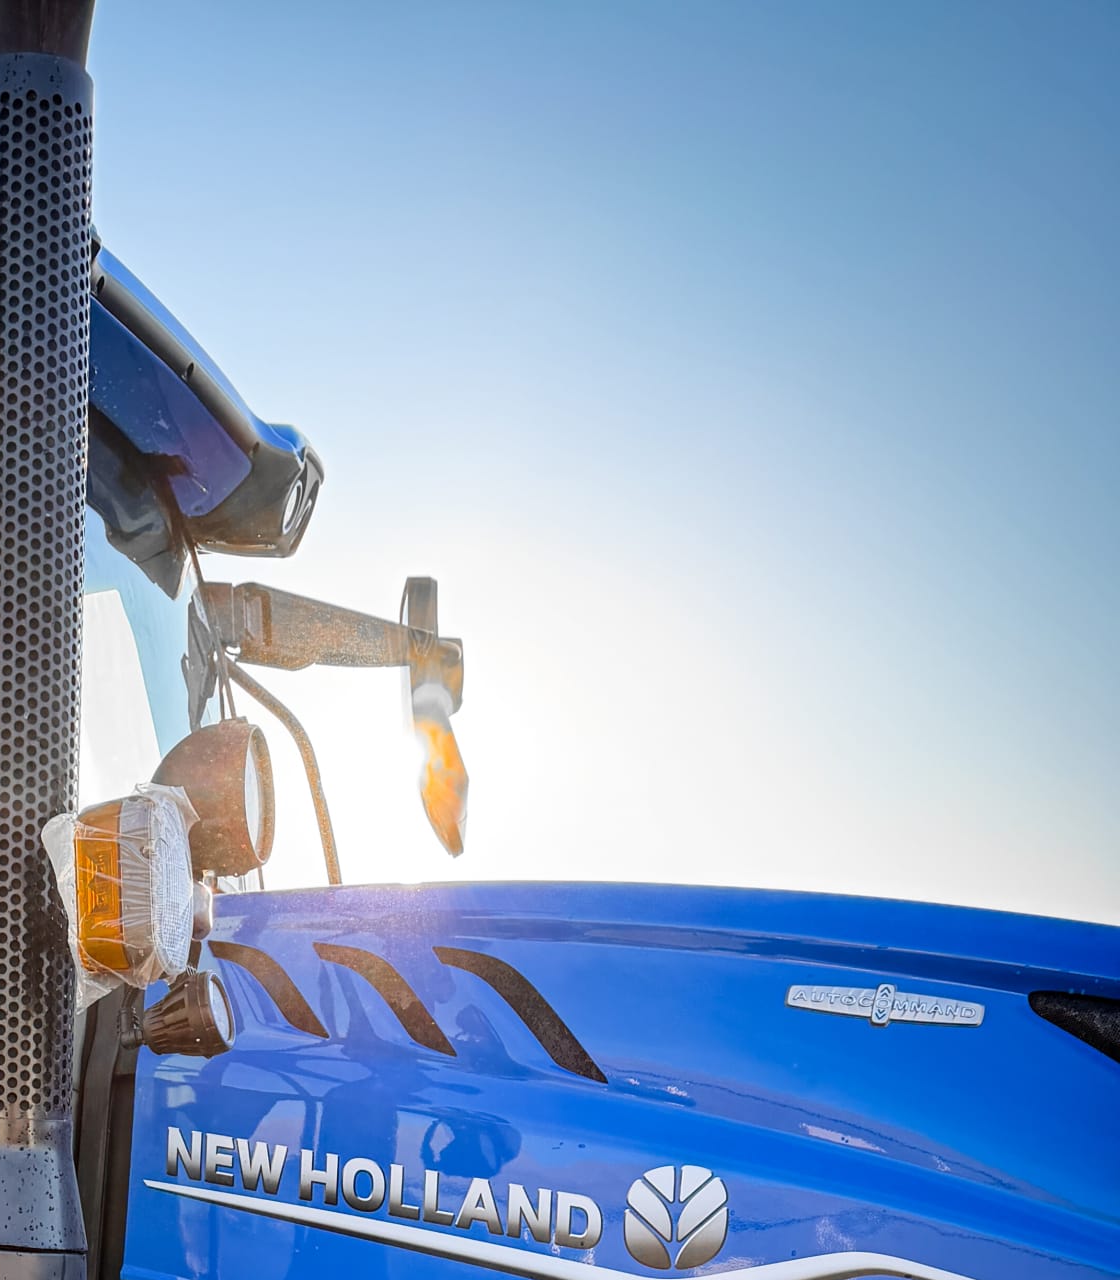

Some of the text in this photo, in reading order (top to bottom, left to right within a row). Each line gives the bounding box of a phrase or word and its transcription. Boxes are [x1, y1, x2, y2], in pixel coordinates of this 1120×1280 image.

[793, 990, 977, 1019] AUTOCOMMAND
[166, 1126, 602, 1250] NEW HOLLAND
